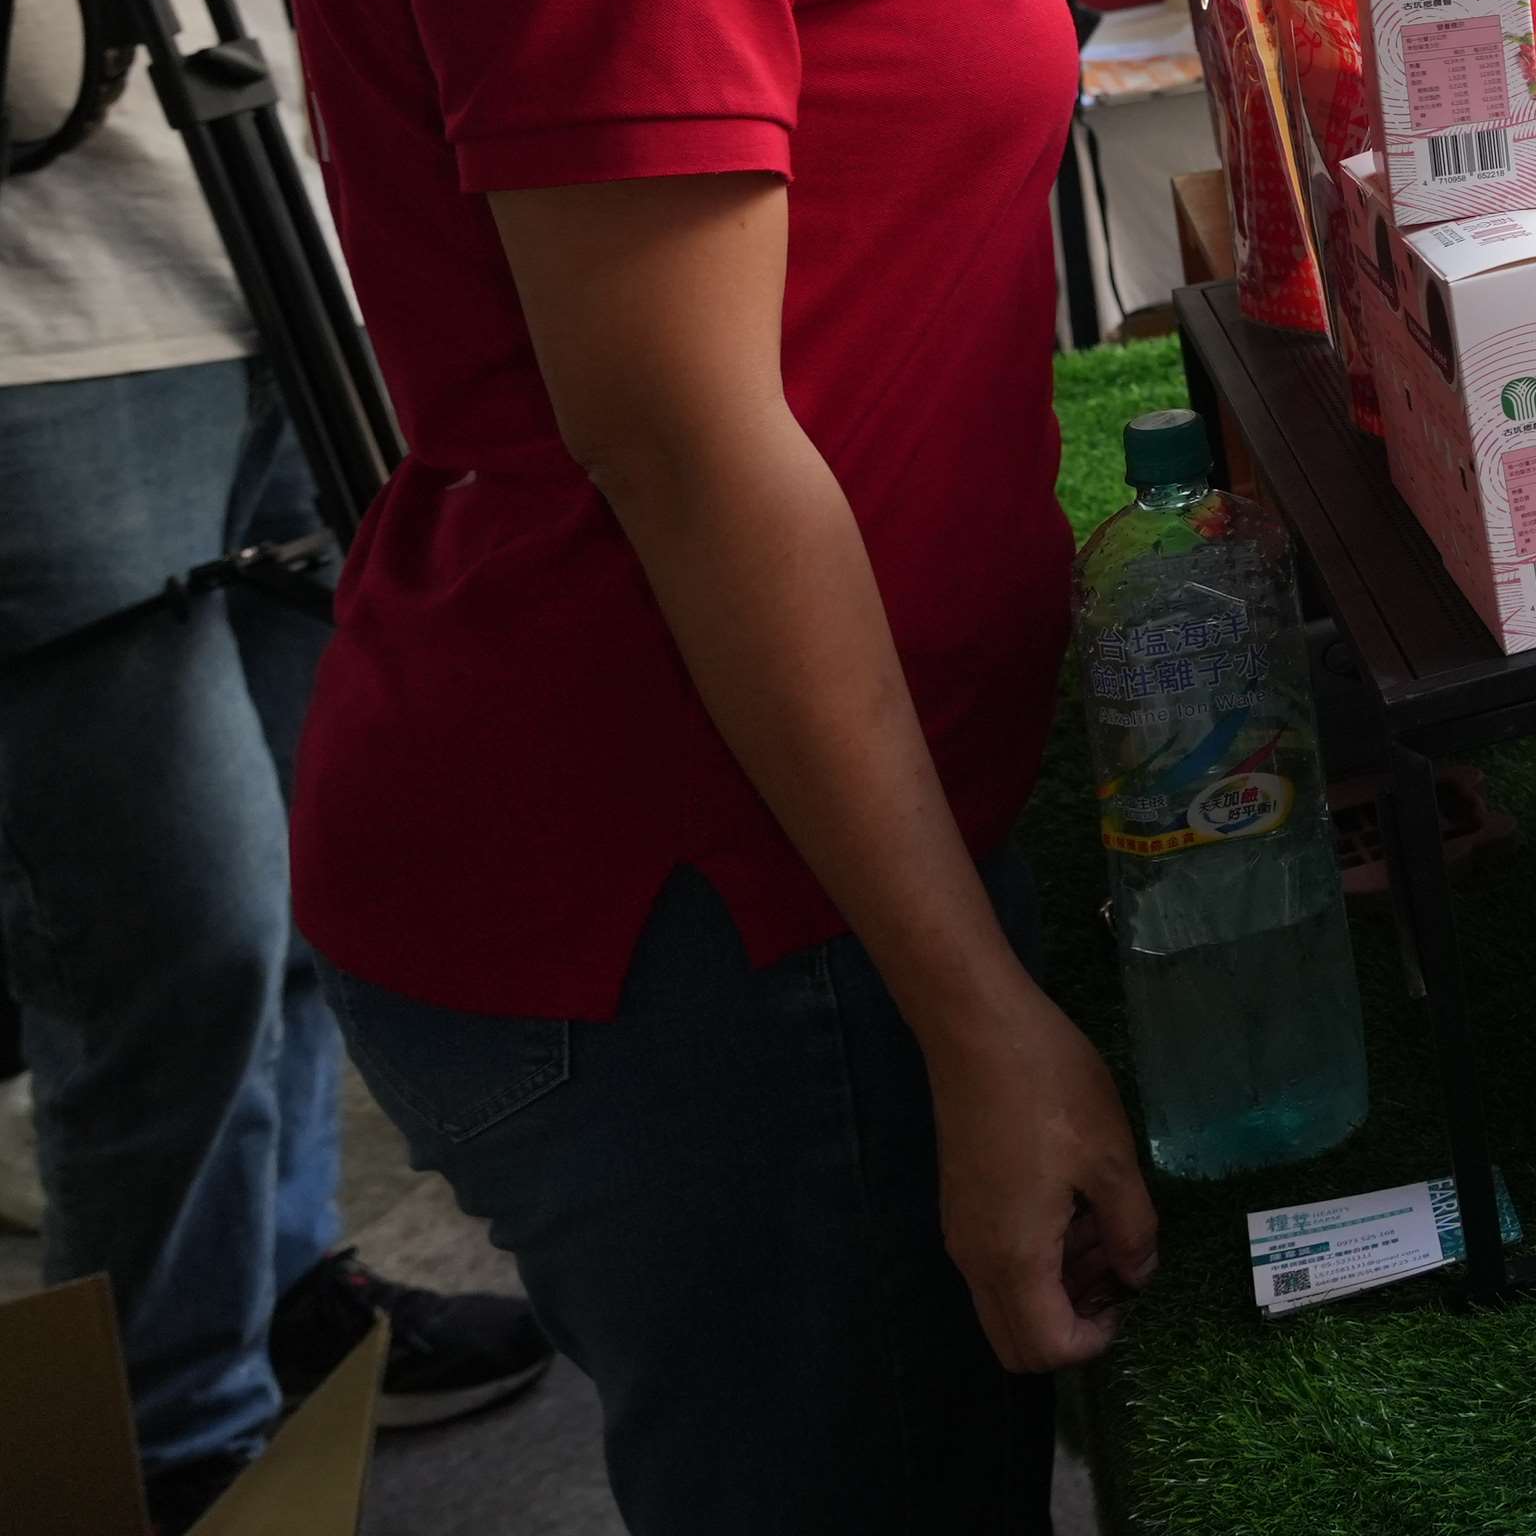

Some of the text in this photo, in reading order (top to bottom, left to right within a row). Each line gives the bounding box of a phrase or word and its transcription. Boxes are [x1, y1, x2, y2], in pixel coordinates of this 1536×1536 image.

[1098, 607, 1250, 663] 台塩海洋
[1089, 643, 1273, 702] 鹼性離子水
[1175, 700, 1211, 721] Ion
[1428, 1178, 1462, 1233] FARM
